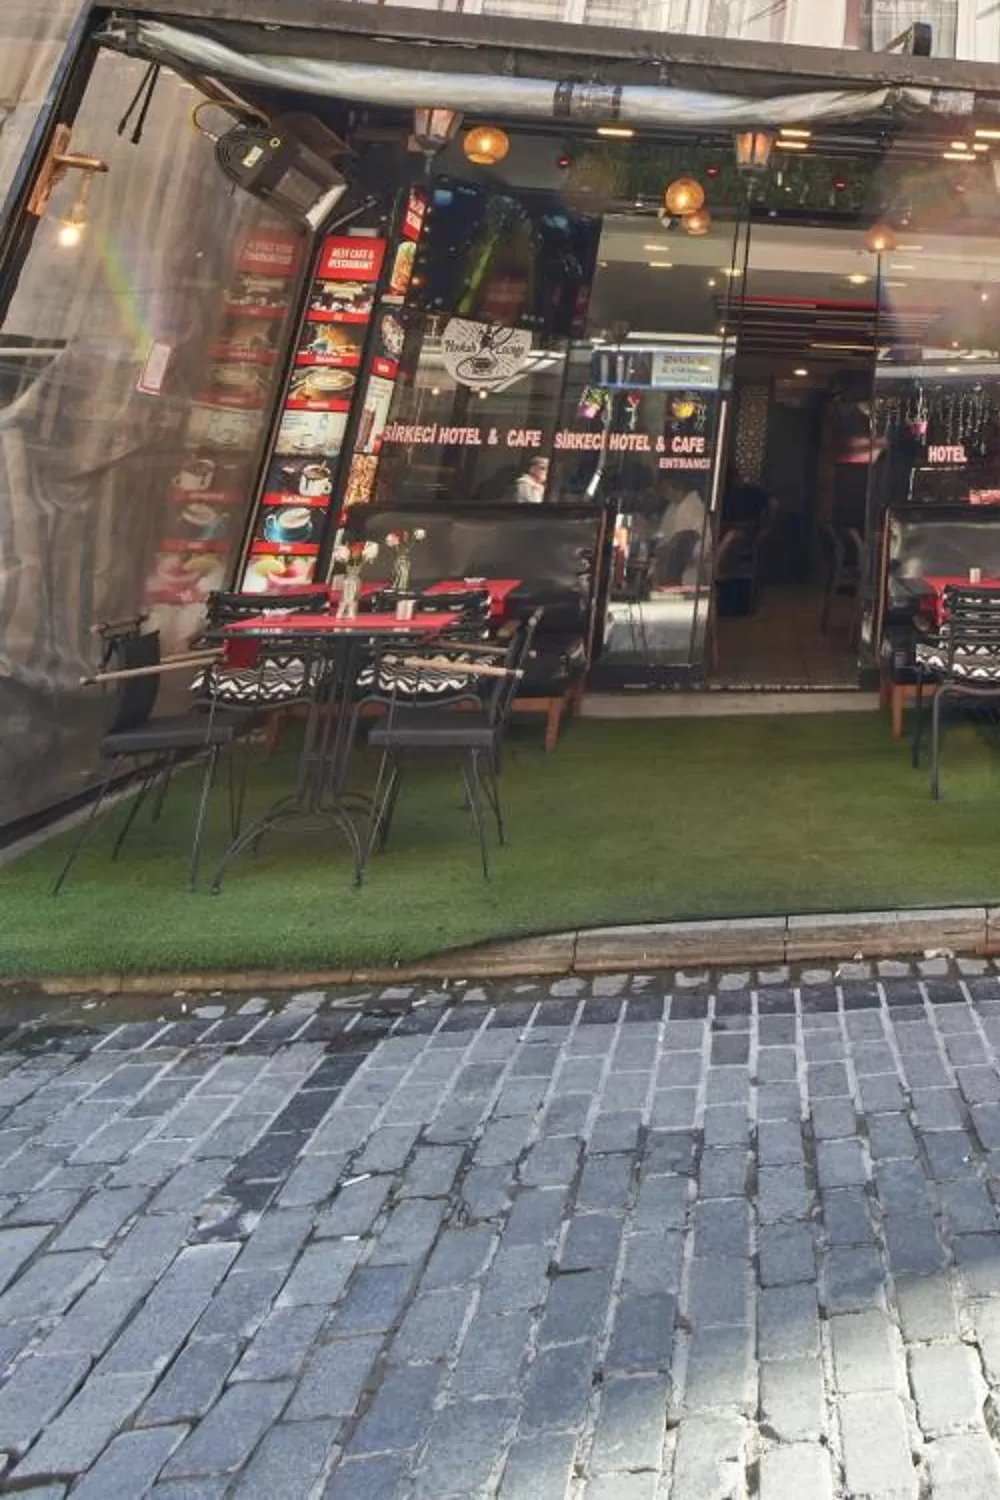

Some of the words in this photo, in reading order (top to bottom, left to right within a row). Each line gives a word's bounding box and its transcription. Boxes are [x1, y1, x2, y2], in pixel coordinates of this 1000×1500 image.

[437, 426, 482, 446] HOTEL
[487, 428, 498, 445] &
[507, 429, 542, 447] CAFE
[609, 432, 651, 451] HOTEL
[655, 435, 665, 453] &
[671, 436, 705, 453] CAFE
[927, 445, 967, 463] HOTEL
